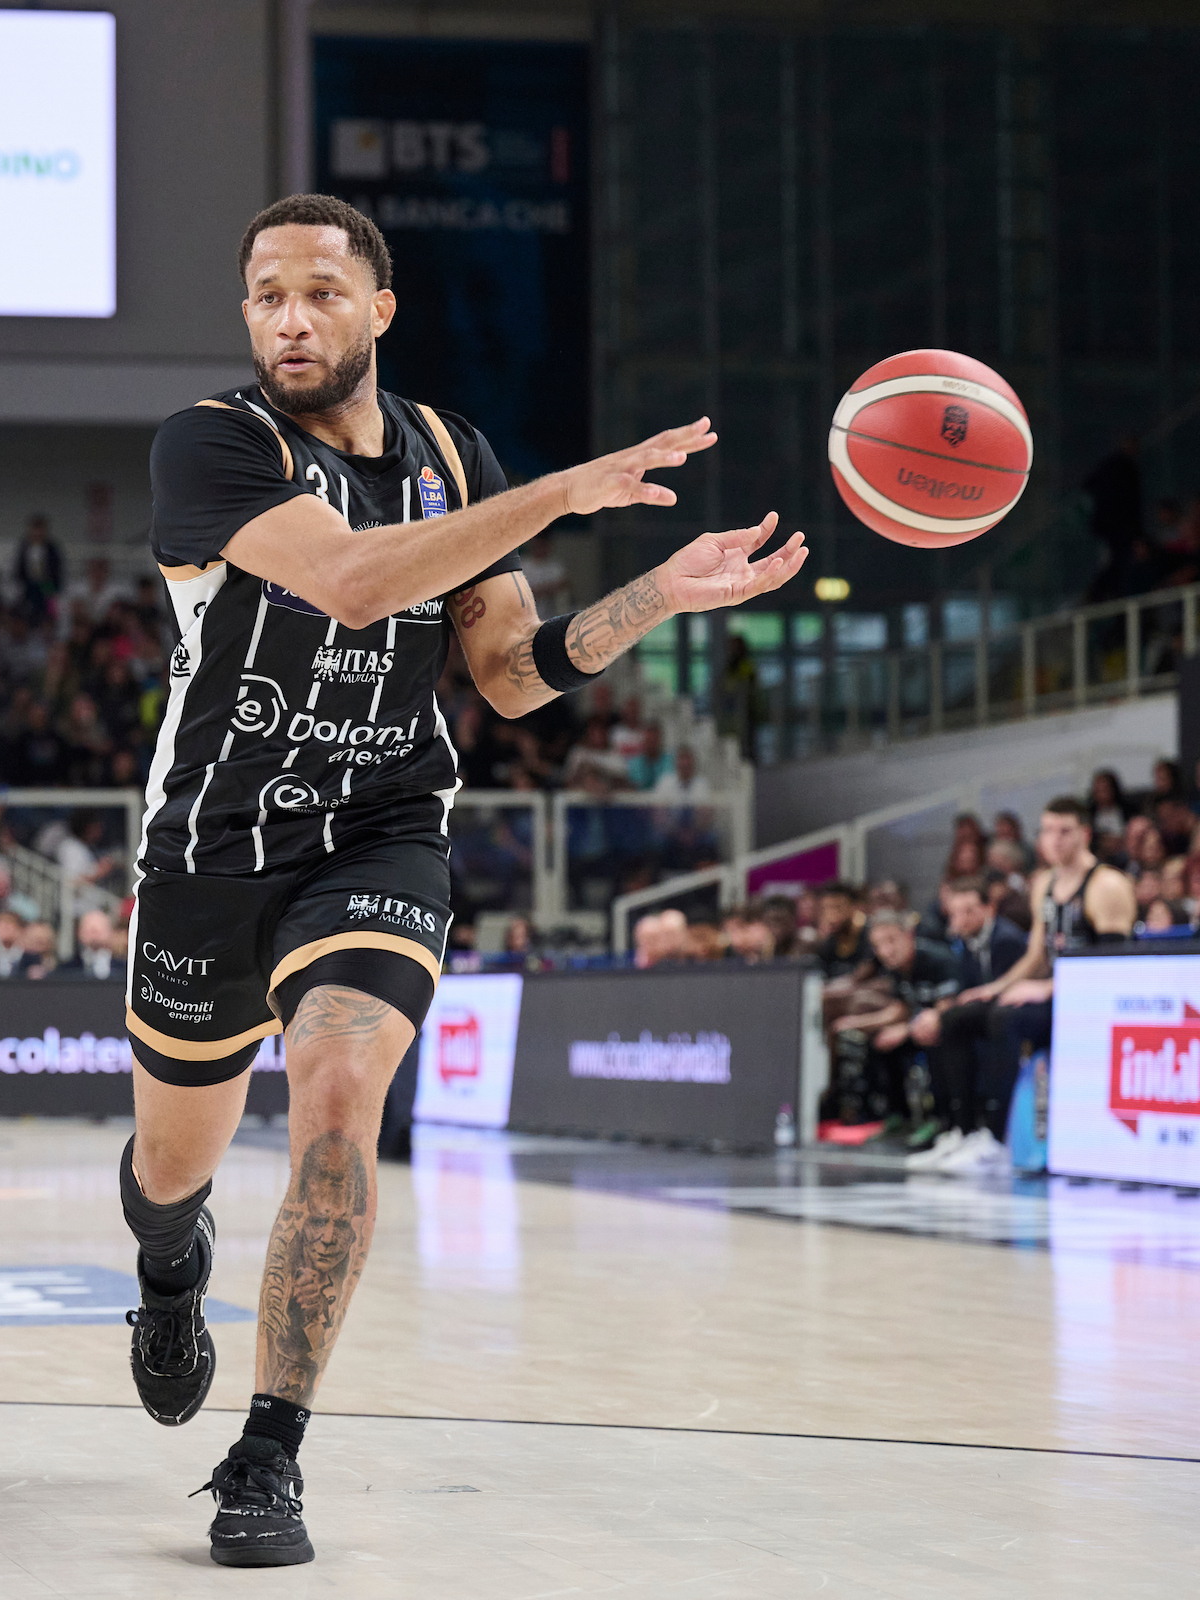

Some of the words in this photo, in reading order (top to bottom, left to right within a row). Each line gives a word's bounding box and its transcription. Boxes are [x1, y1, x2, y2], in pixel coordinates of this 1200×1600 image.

[392, 120, 491, 173] BTS
[897, 467, 984, 501] molten
[423, 491, 444, 503] LBA
[341, 649, 395, 674] ITAS
[379, 913, 423, 933] MUTUA
[383, 898, 436, 932] ITAS
[143, 942, 215, 976] CAVIT
[157, 971, 189, 986] TRENTO
[154, 991, 214, 1013] Dolomiti
[168, 1011, 212, 1024] energia
